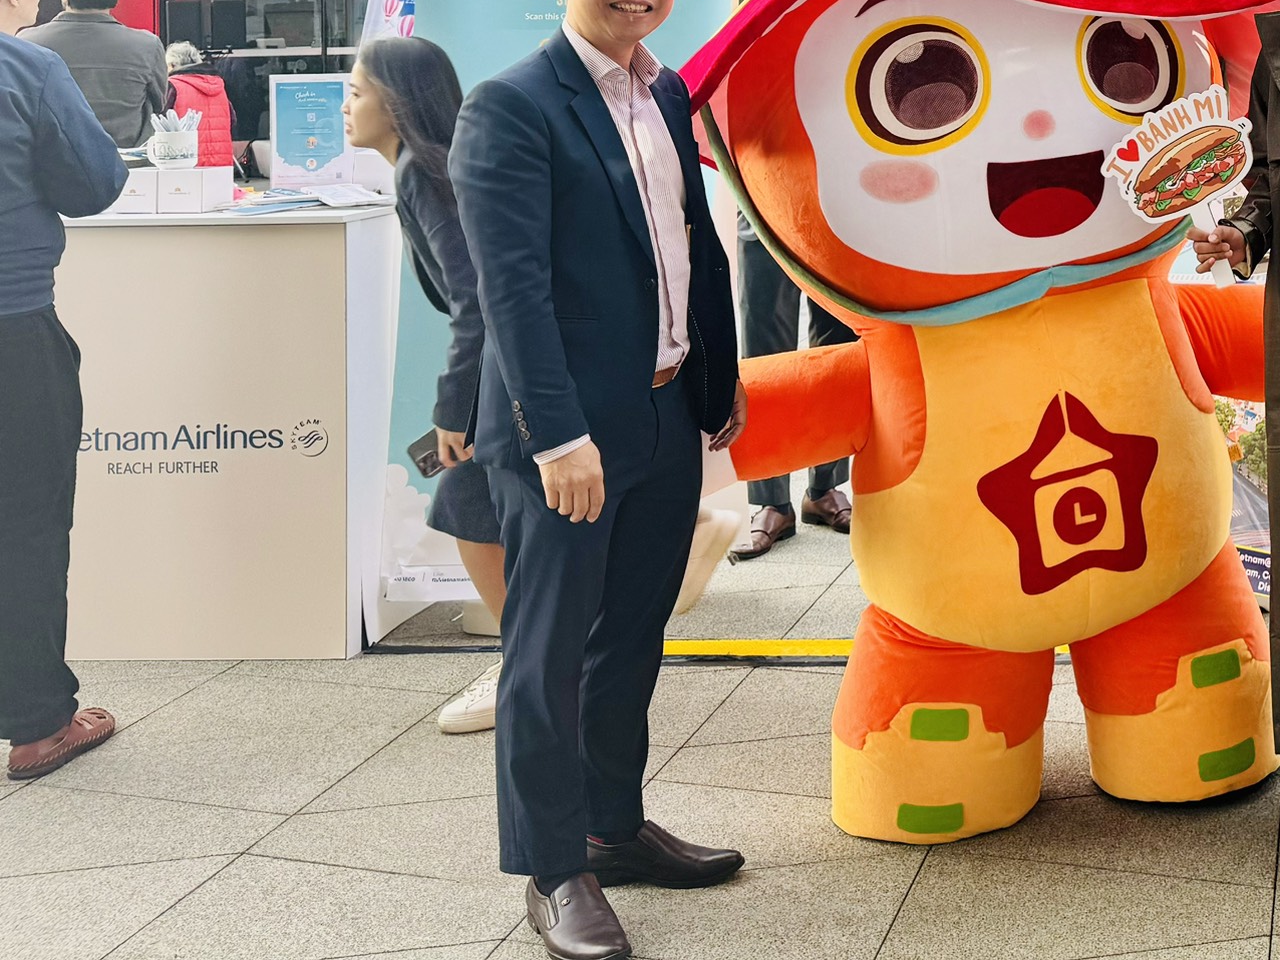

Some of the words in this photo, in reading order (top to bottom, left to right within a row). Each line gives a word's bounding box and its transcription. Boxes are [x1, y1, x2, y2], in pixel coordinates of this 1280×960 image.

[525, 12, 543, 20] Scan
[545, 12, 559, 20] this
[1106, 157, 1133, 184] I
[1136, 103, 1193, 153] BÁNH
[1193, 89, 1222, 122] MÌ
[291, 419, 320, 450] SKYTEAM
[107, 462, 153, 475] REACH
[158, 461, 219, 474] FURTHER
[1239, 551, 1271, 568] etnam@
